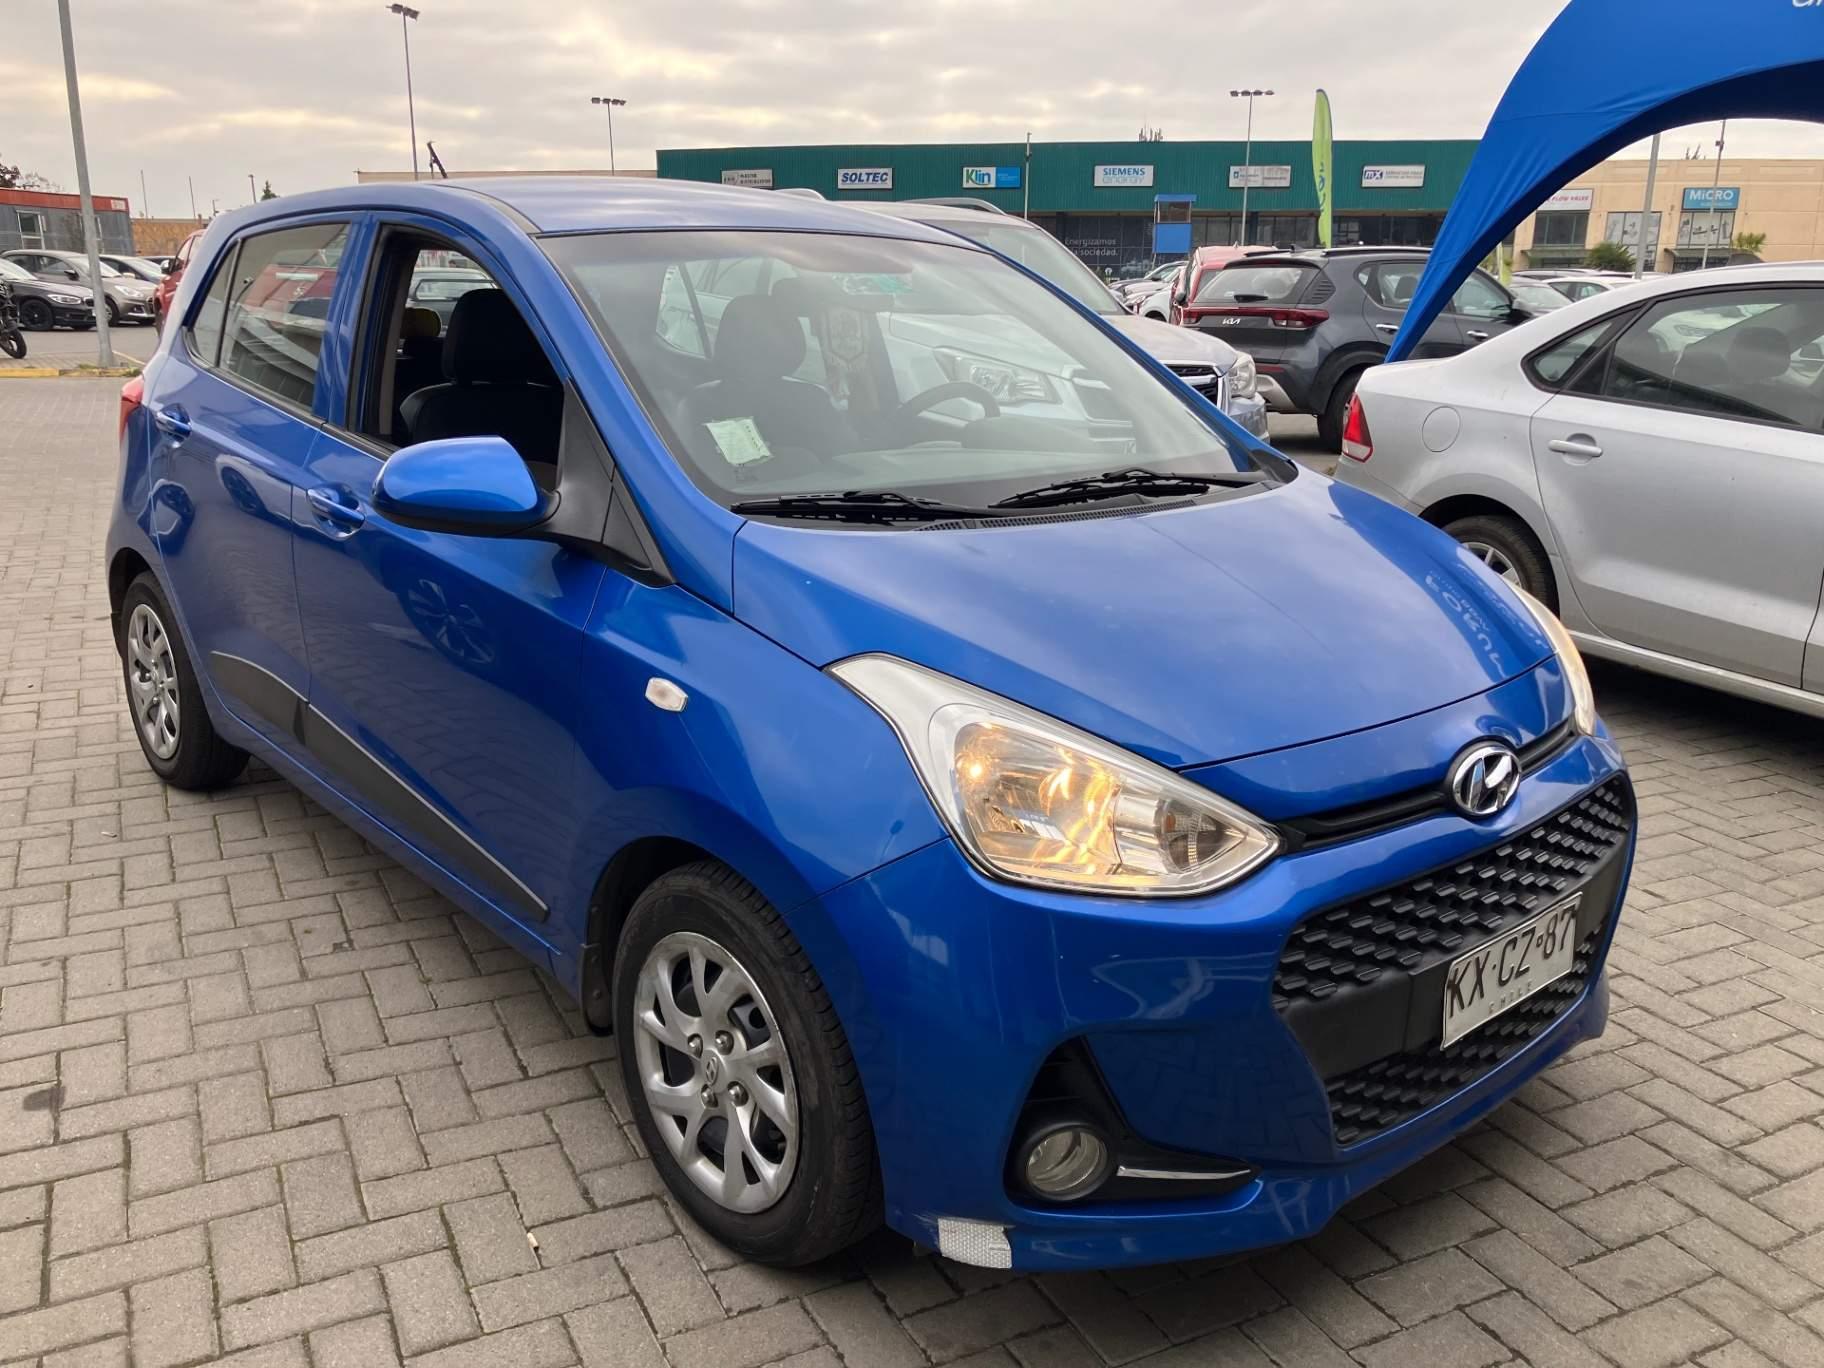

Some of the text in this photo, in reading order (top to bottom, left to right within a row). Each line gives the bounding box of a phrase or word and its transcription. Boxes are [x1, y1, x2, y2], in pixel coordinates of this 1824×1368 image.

[965, 168, 992, 185] Klin
[1103, 167, 1146, 176] SIEMENS
[841, 172, 889, 183] SOLTEC
